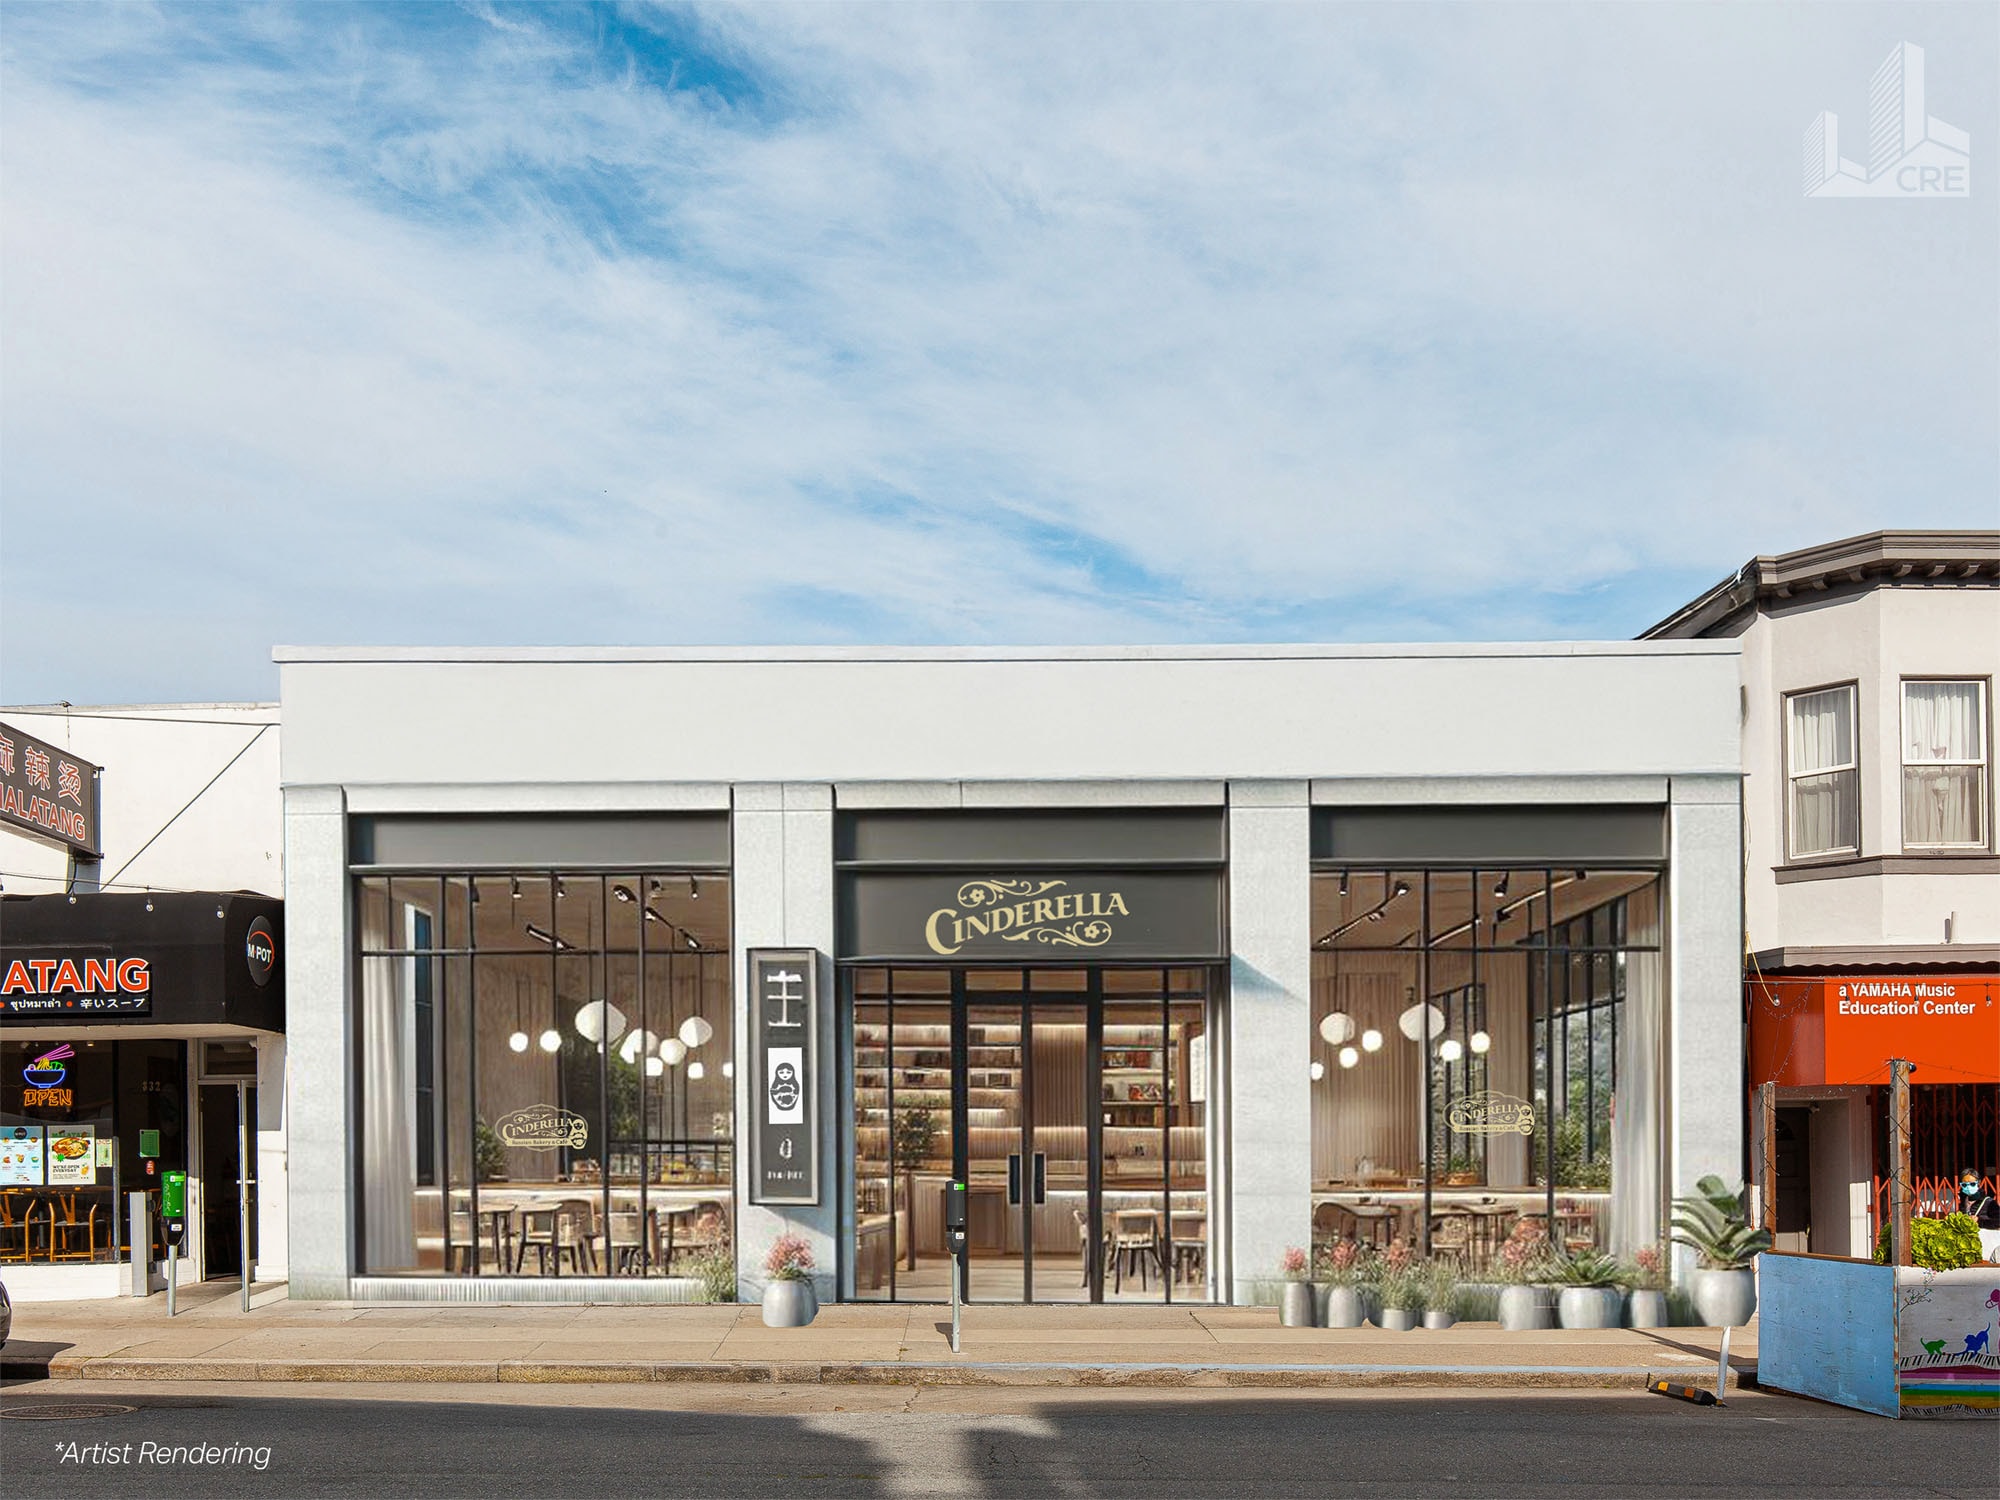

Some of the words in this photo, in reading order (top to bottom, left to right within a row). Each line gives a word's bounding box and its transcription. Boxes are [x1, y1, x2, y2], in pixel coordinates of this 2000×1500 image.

[0, 781, 85, 841] ALATANG
[925, 892, 1130, 955] CINDERELLA
[1, 957, 150, 994] ATANG
[1838, 986, 1847, 997] a
[1850, 983, 1912, 997] YAMAHA
[1915, 983, 1956, 997] Music
[1838, 1001, 1919, 1015] Education
[1923, 1001, 1976, 1015] Center
[23, 1088, 72, 1107] OPEN
[1450, 1104, 1520, 1126] CINDERELLA
[502, 1118, 574, 1140] CINDERELLA
